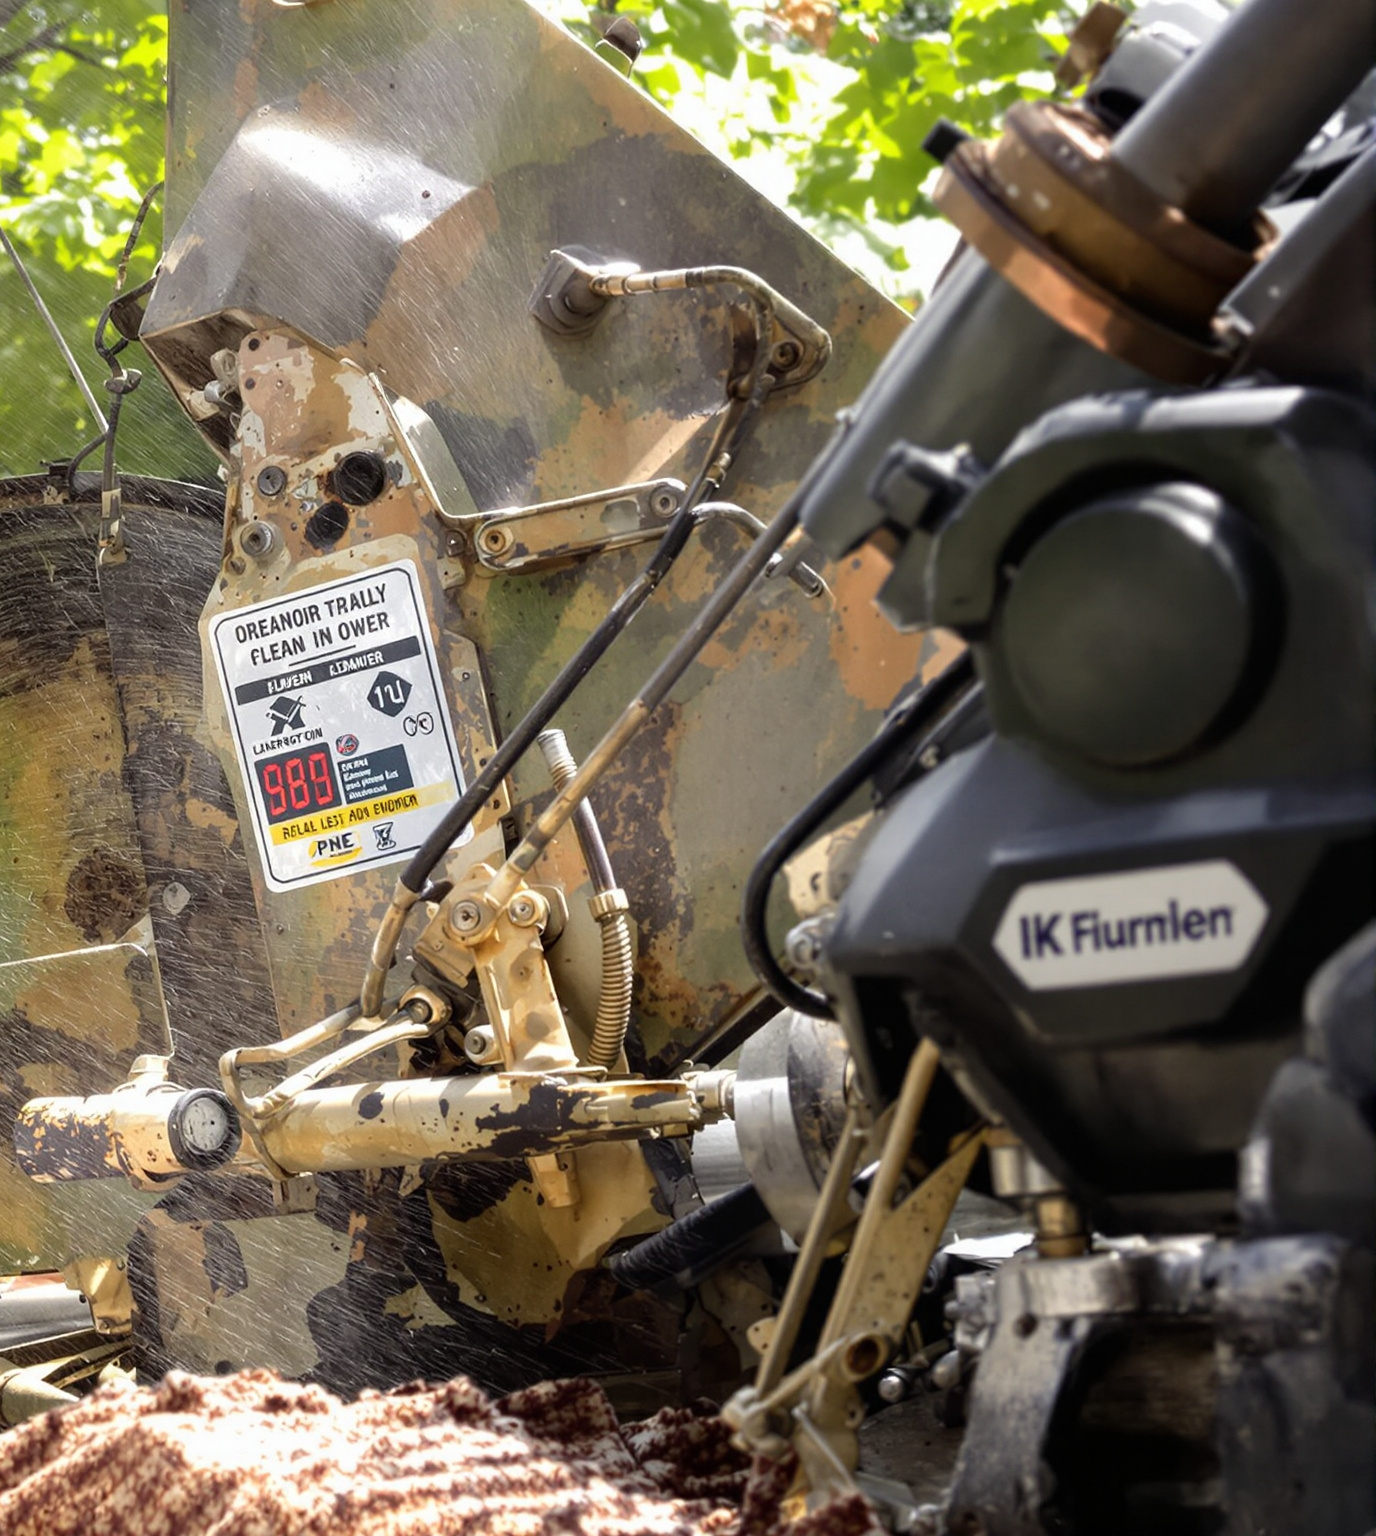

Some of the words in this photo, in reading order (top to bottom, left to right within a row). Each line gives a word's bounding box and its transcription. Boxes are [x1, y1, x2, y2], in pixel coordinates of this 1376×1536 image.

[235, 604, 321, 643] OREANOIR
[324, 583, 386, 617] TRALLY
[312, 626, 333, 648] IN
[338, 611, 390, 641] OWER
[317, 832, 355, 856] PNE
